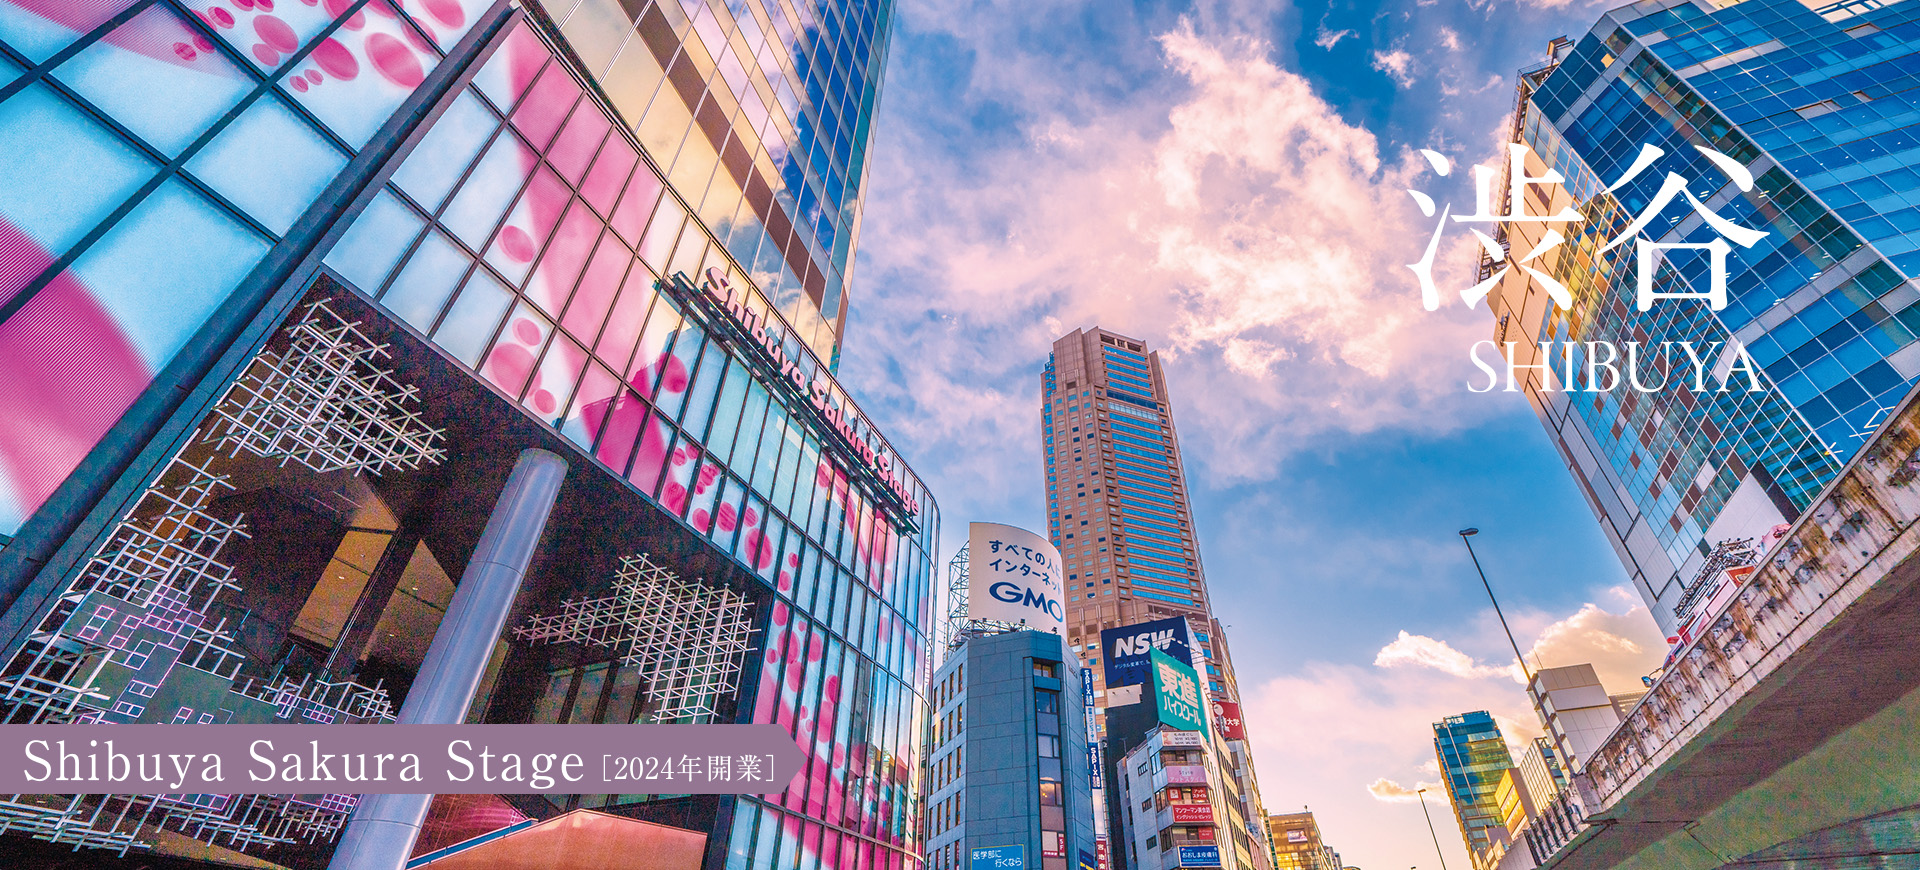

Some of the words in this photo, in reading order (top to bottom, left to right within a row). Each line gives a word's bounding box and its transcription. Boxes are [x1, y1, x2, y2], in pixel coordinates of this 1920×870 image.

[704, 266, 806, 391] Shibuya
[809, 379, 874, 467] Sakura
[875, 454, 919, 517] Stage
[988, 539, 1061, 580] すべての人に
[988, 581, 1064, 623] GMO
[1114, 629, 1175, 658] NSW
[1083, 670, 1092, 695] SAPIX
[1157, 662, 1200, 710] 東進
[1163, 695, 1202, 727] ハイスクール
[1090, 747, 1099, 776] SAPIX
[972, 849, 1002, 861] 医学部に
[994, 857, 1022, 868] 行くなら
